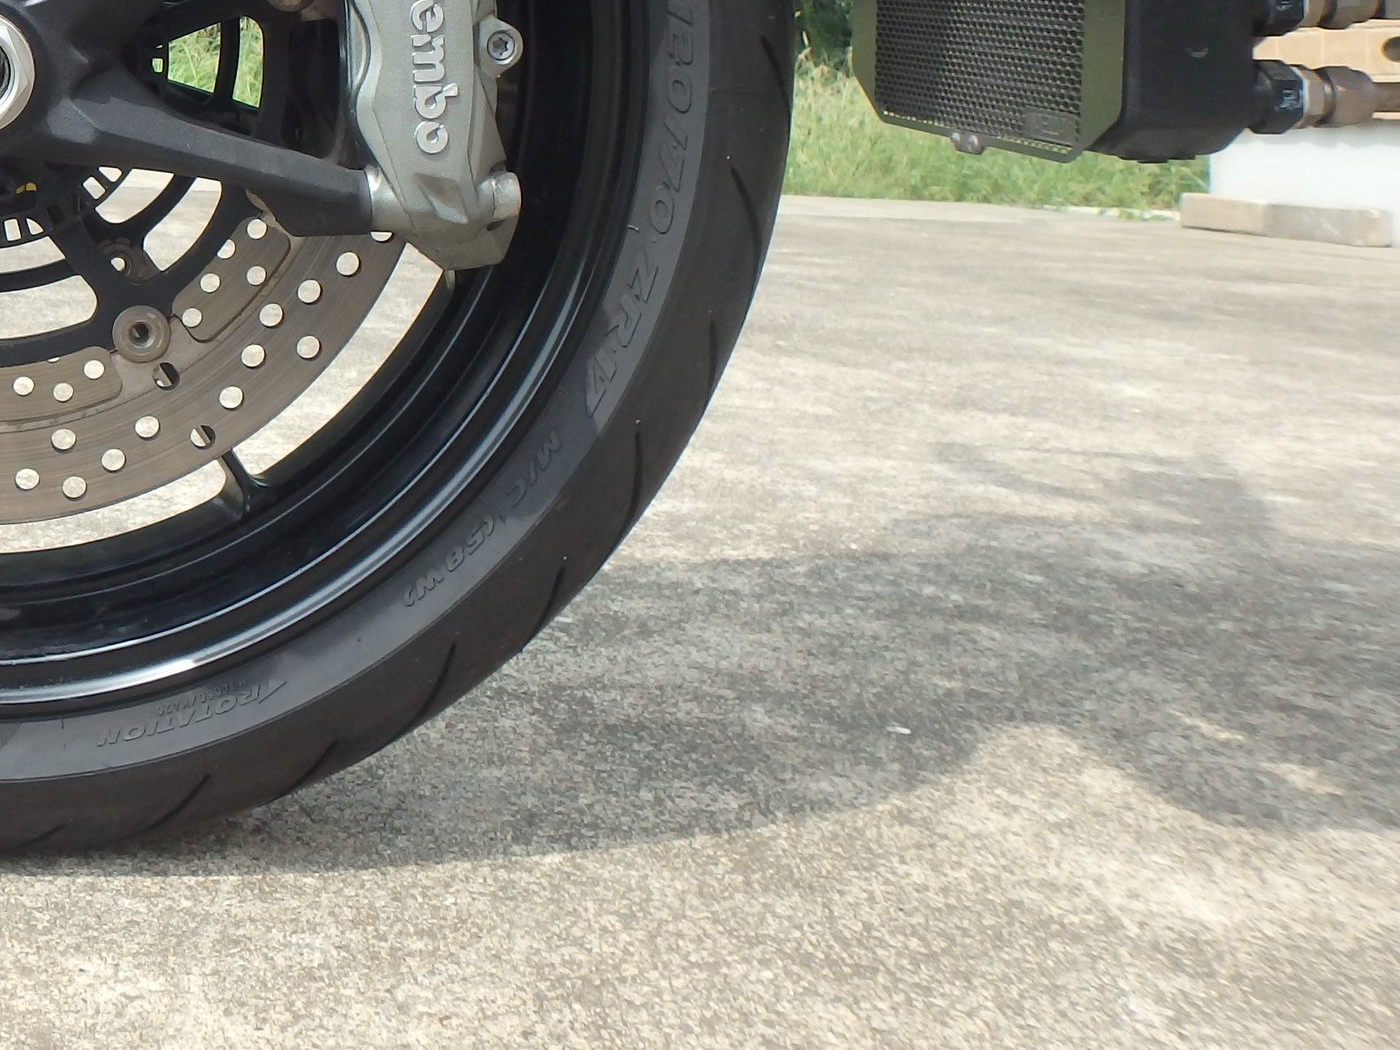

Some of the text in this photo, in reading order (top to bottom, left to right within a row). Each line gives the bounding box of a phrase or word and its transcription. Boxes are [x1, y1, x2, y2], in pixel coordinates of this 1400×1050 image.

[647, 0, 694, 236] 120/70
[504, 431, 564, 508] M/C
[95, 680, 265, 750] ROTATION
